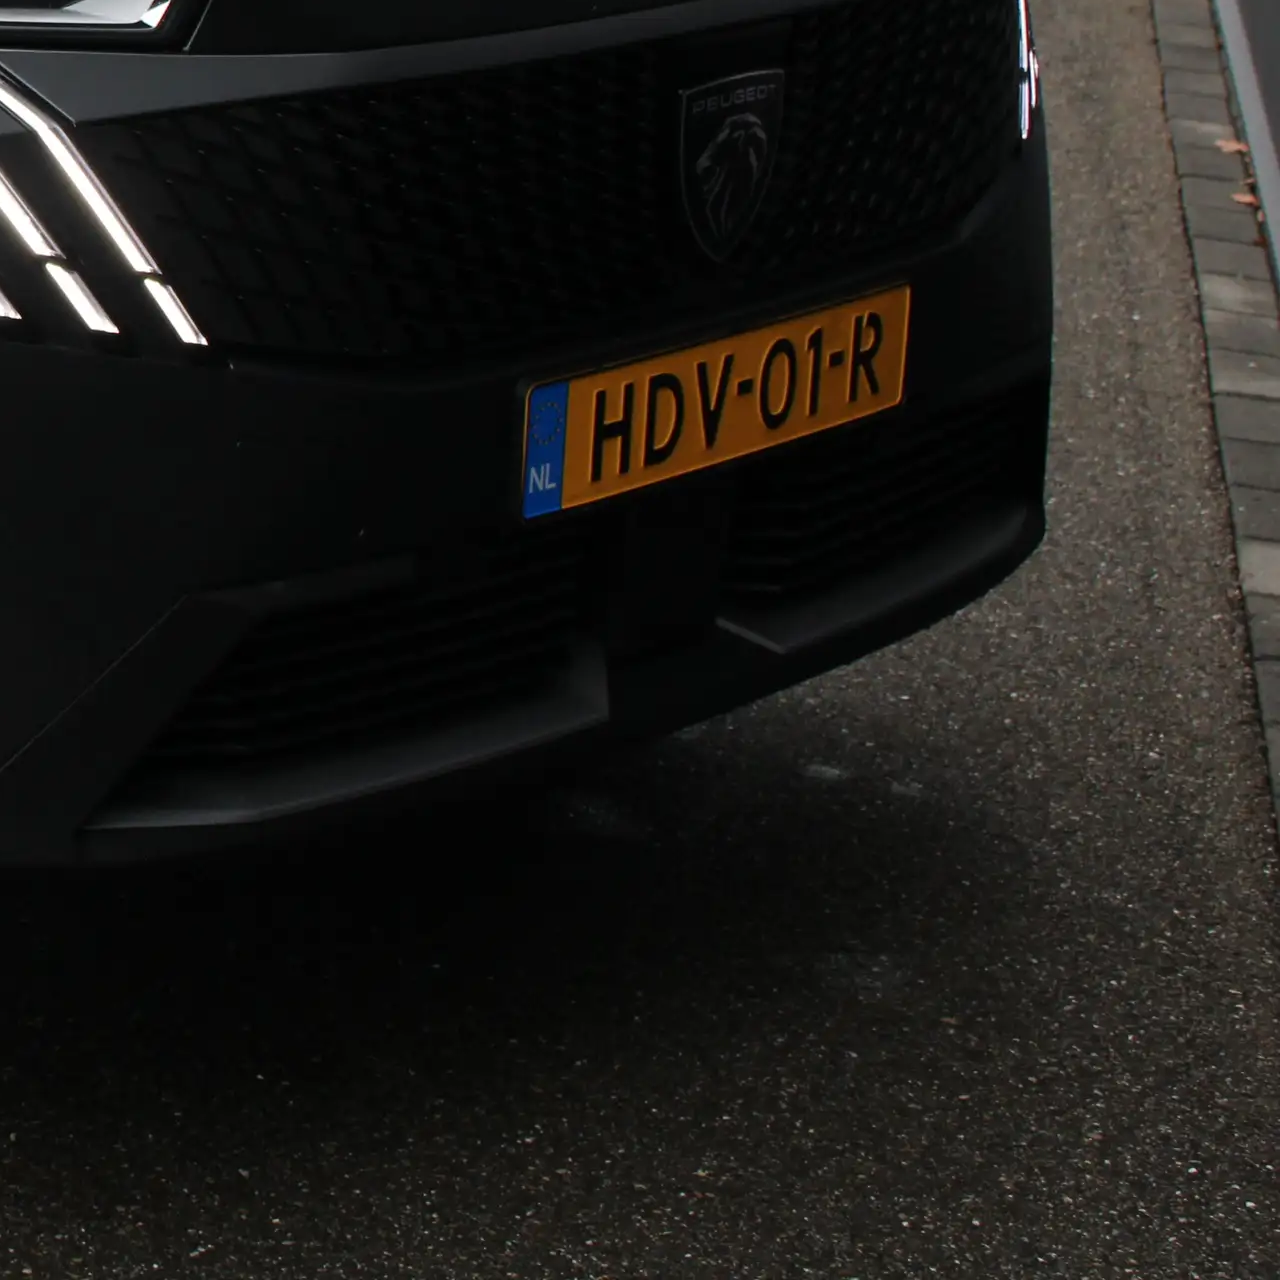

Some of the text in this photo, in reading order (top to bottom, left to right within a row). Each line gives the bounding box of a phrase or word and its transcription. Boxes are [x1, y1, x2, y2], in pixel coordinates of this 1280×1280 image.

[691, 83, 777, 115] PEUGEOT
[589, 310, 884, 483] HDV-01-R
[527, 461, 557, 495] NL
